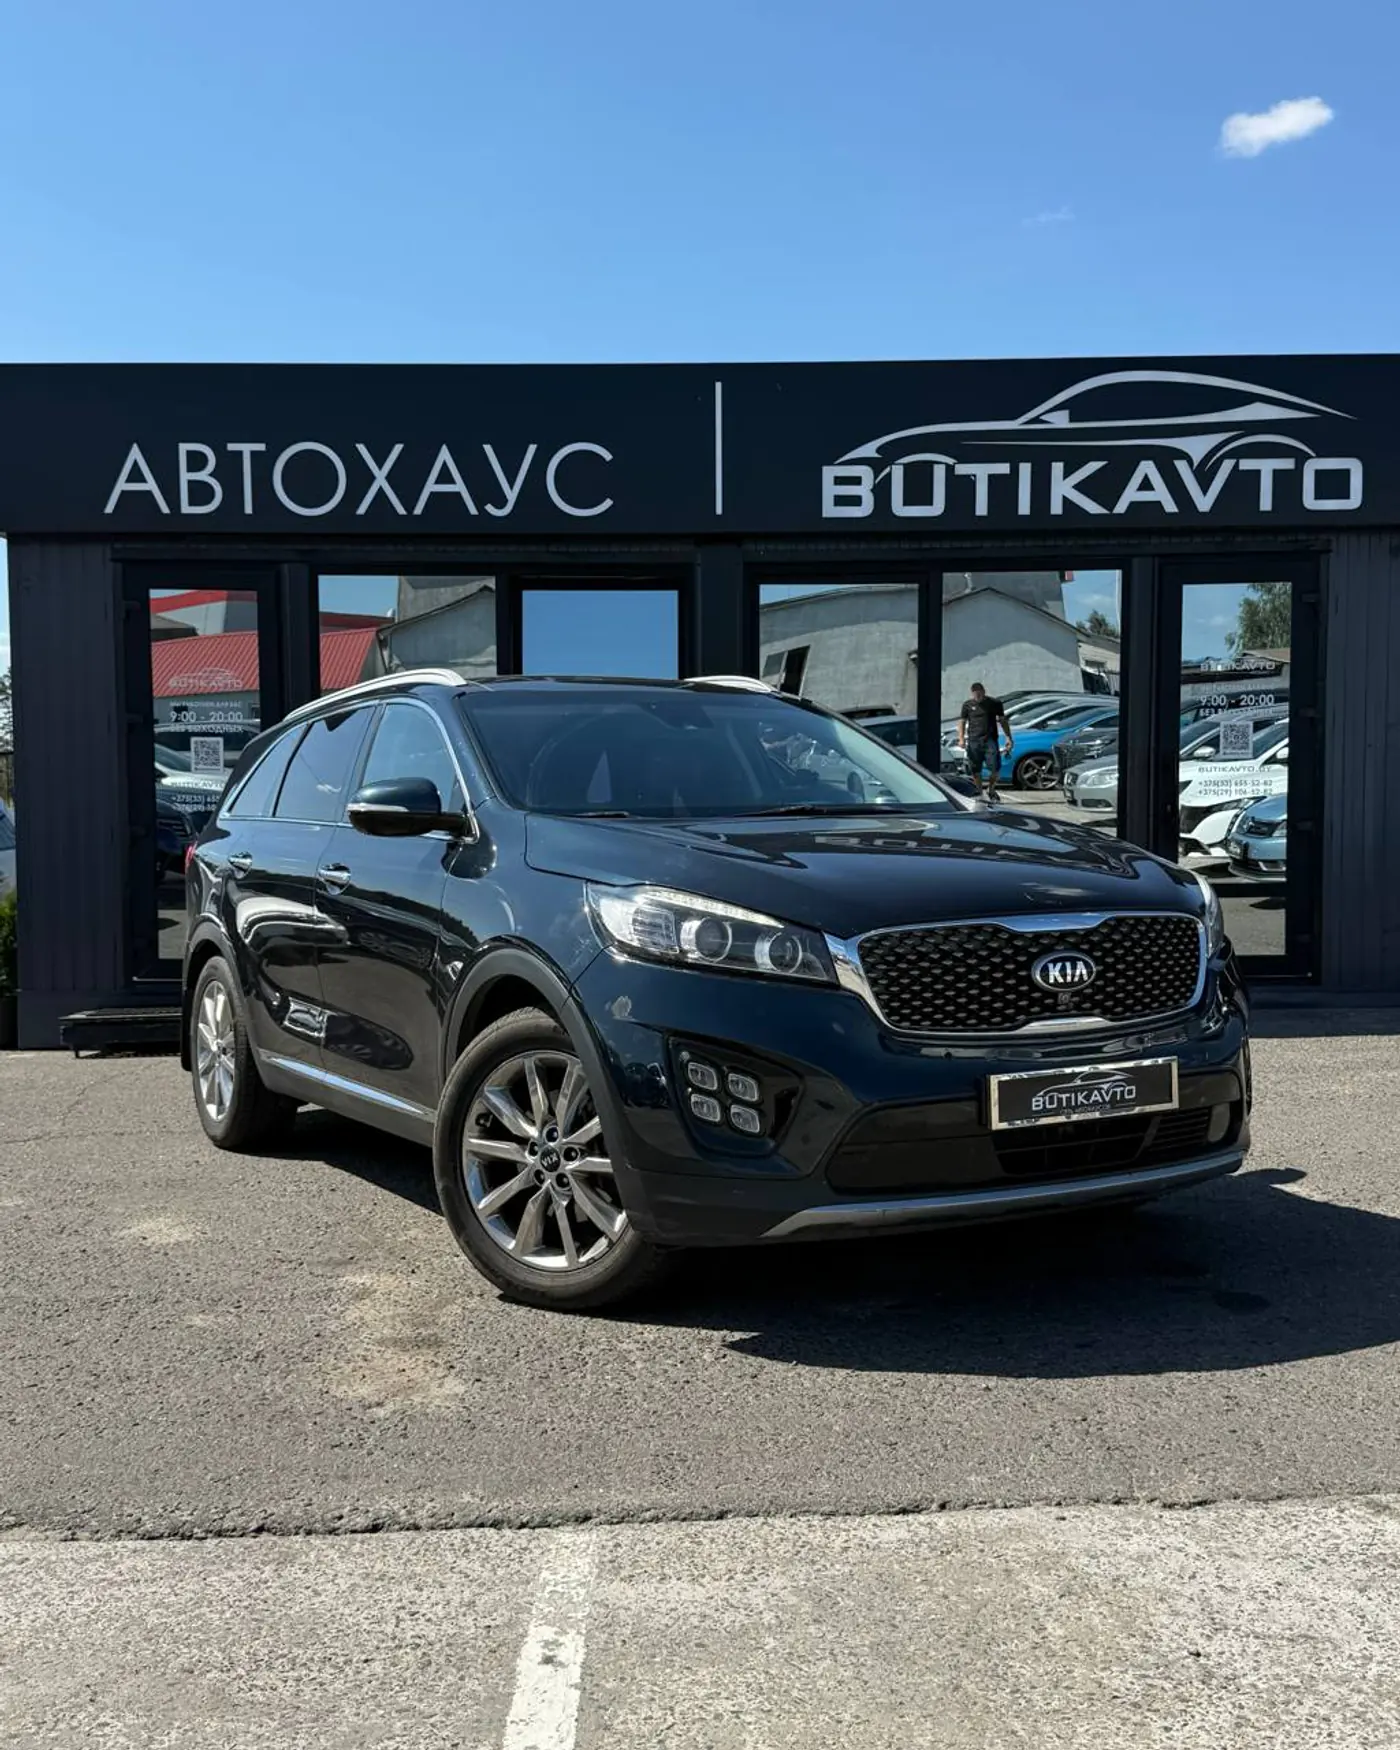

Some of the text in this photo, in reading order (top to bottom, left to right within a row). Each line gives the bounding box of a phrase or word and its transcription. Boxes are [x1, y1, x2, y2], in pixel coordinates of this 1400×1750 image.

[103, 441, 614, 516] АВТОХАУС
[822, 457, 1363, 517] BUTIKAVTO
[1200, 694, 1227, 706] 9:00
[1240, 694, 1275, 706] 20:00
[170, 711, 197, 722] 9:00
[209, 711, 244, 722] 20:00
[1047, 961, 1089, 983] KIA
[1031, 1086, 1137, 1111] BUTIKAVTO
